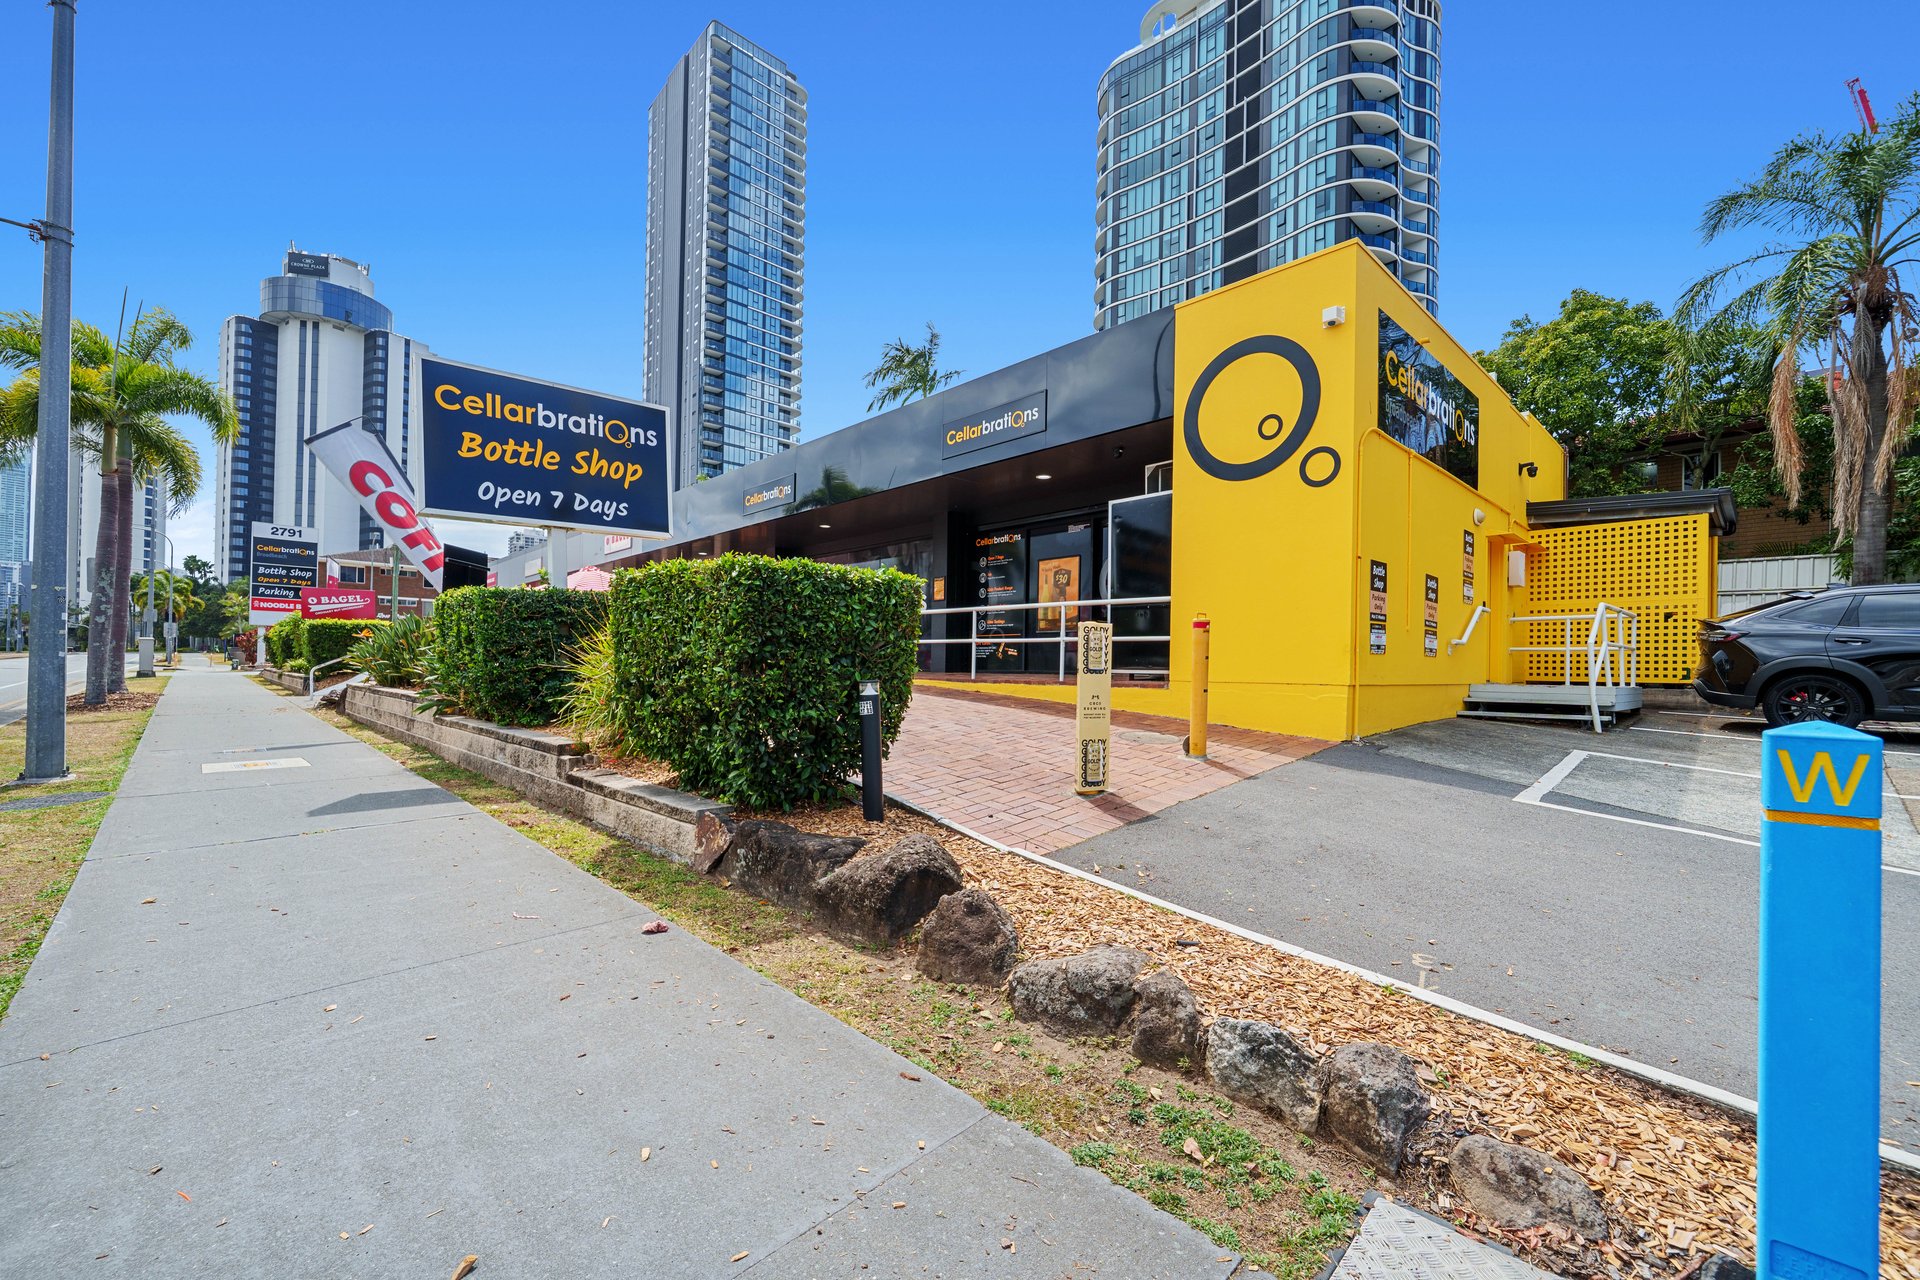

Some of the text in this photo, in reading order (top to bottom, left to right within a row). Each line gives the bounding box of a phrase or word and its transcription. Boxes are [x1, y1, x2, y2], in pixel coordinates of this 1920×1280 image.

[1385, 350, 1475, 447] Cellarbrations
[434, 384, 658, 449] Cellarbrations
[946, 406, 1039, 445] Cellarbrations
[457, 431, 643, 490] Bottle Shop
[477, 481, 629, 522] Open 7 Days
[745, 484, 792, 507] Cellarbrations
[270, 526, 303, 538] 2791
[975, 533, 1022, 547] Cellarbrations
[256, 544, 315, 556] Cellarbrations
[257, 566, 313, 579] Bottle Shop
[1373, 577, 1385, 592] Shop
[258, 587, 295, 599] Parking
[307, 594, 364, 605] O BAGEL
[1371, 593, 1386, 604] Parking
[260, 601, 295, 609] NOODLE
[1373, 603, 1384, 613] Only
[1777, 749, 1871, 807] W
